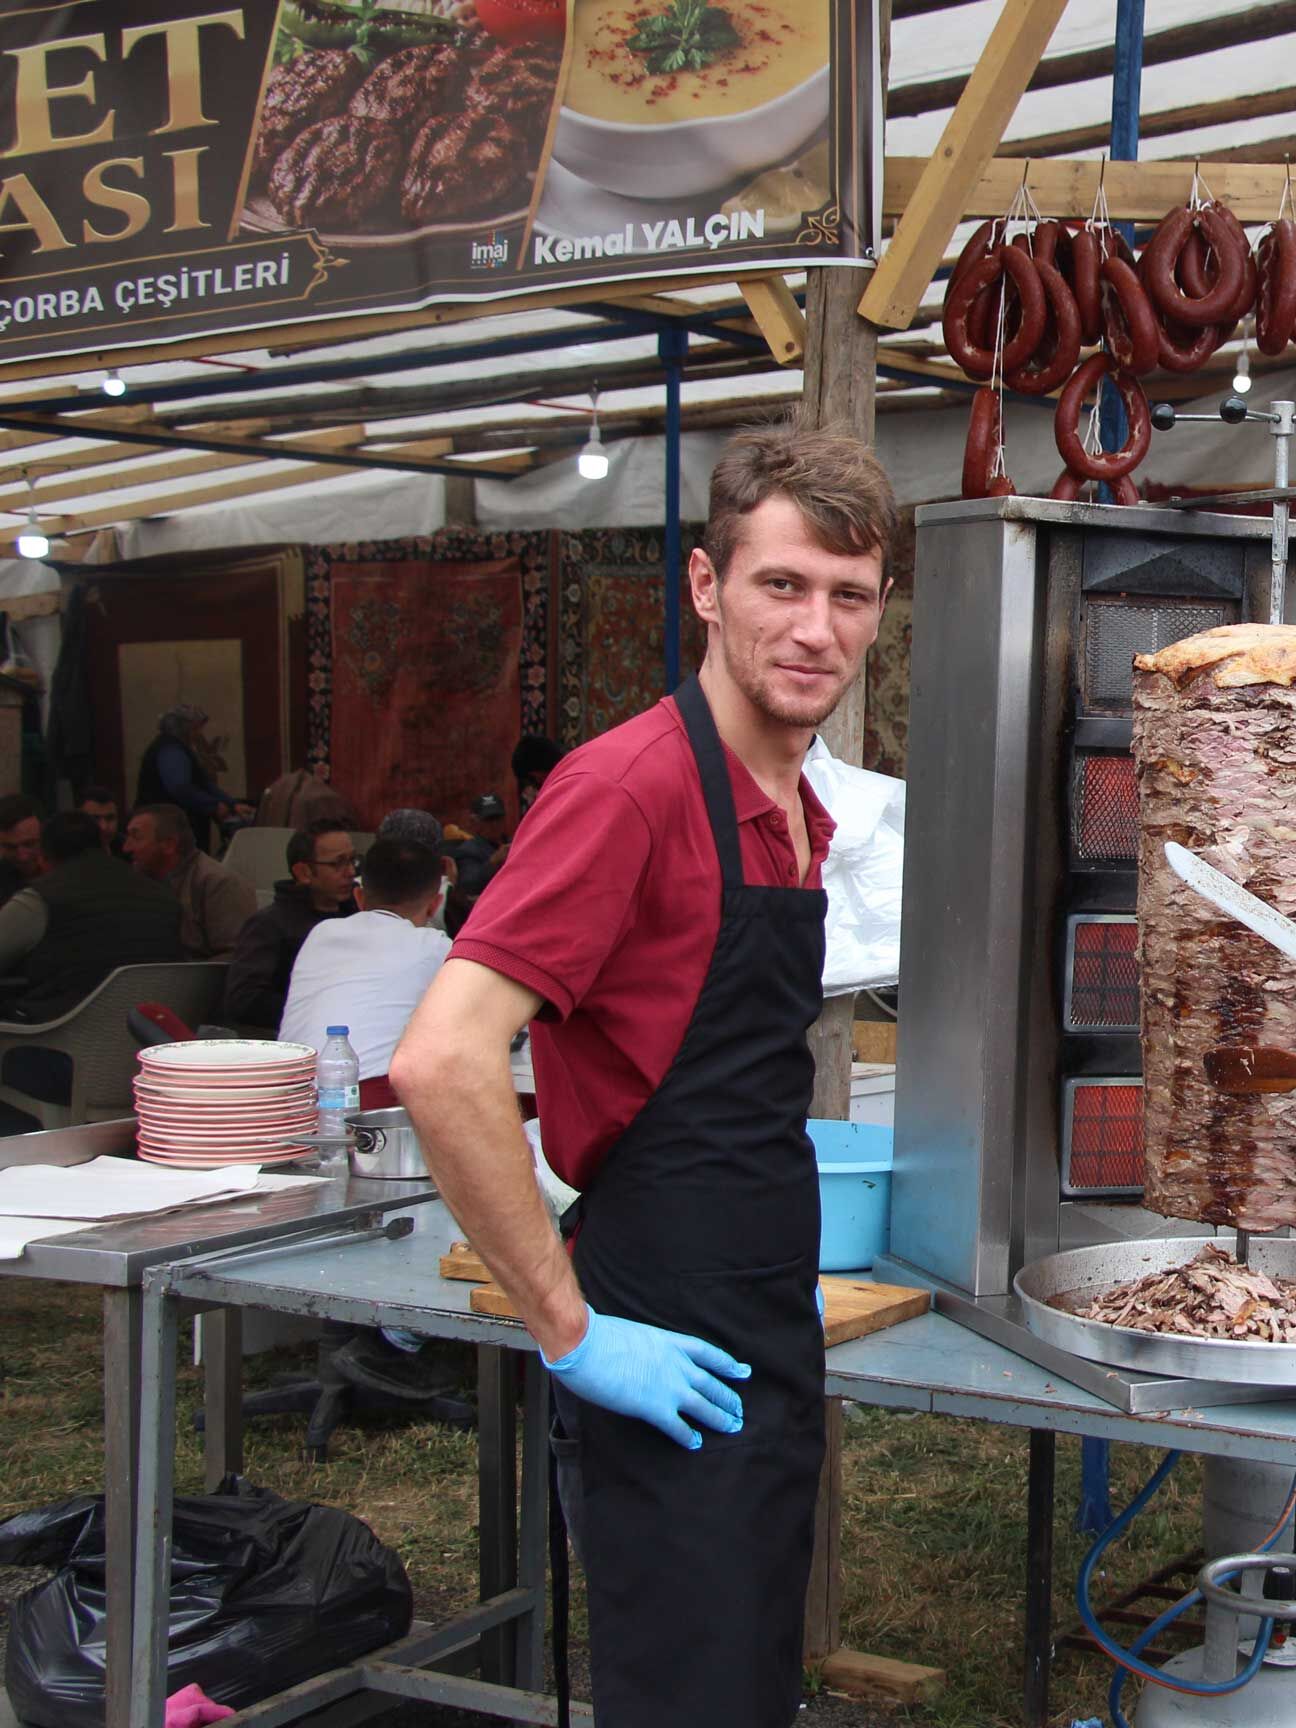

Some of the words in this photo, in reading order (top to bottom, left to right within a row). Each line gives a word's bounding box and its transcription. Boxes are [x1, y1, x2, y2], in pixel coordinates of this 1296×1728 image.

[0, 8, 245, 158] ET
[0, 146, 212, 257] ASI
[472, 240, 508, 262] imaj
[534, 224, 634, 265] Kemal
[642, 209, 765, 250] YALÇIN
[115, 252, 290, 313] ÇEŞİTLERİ
